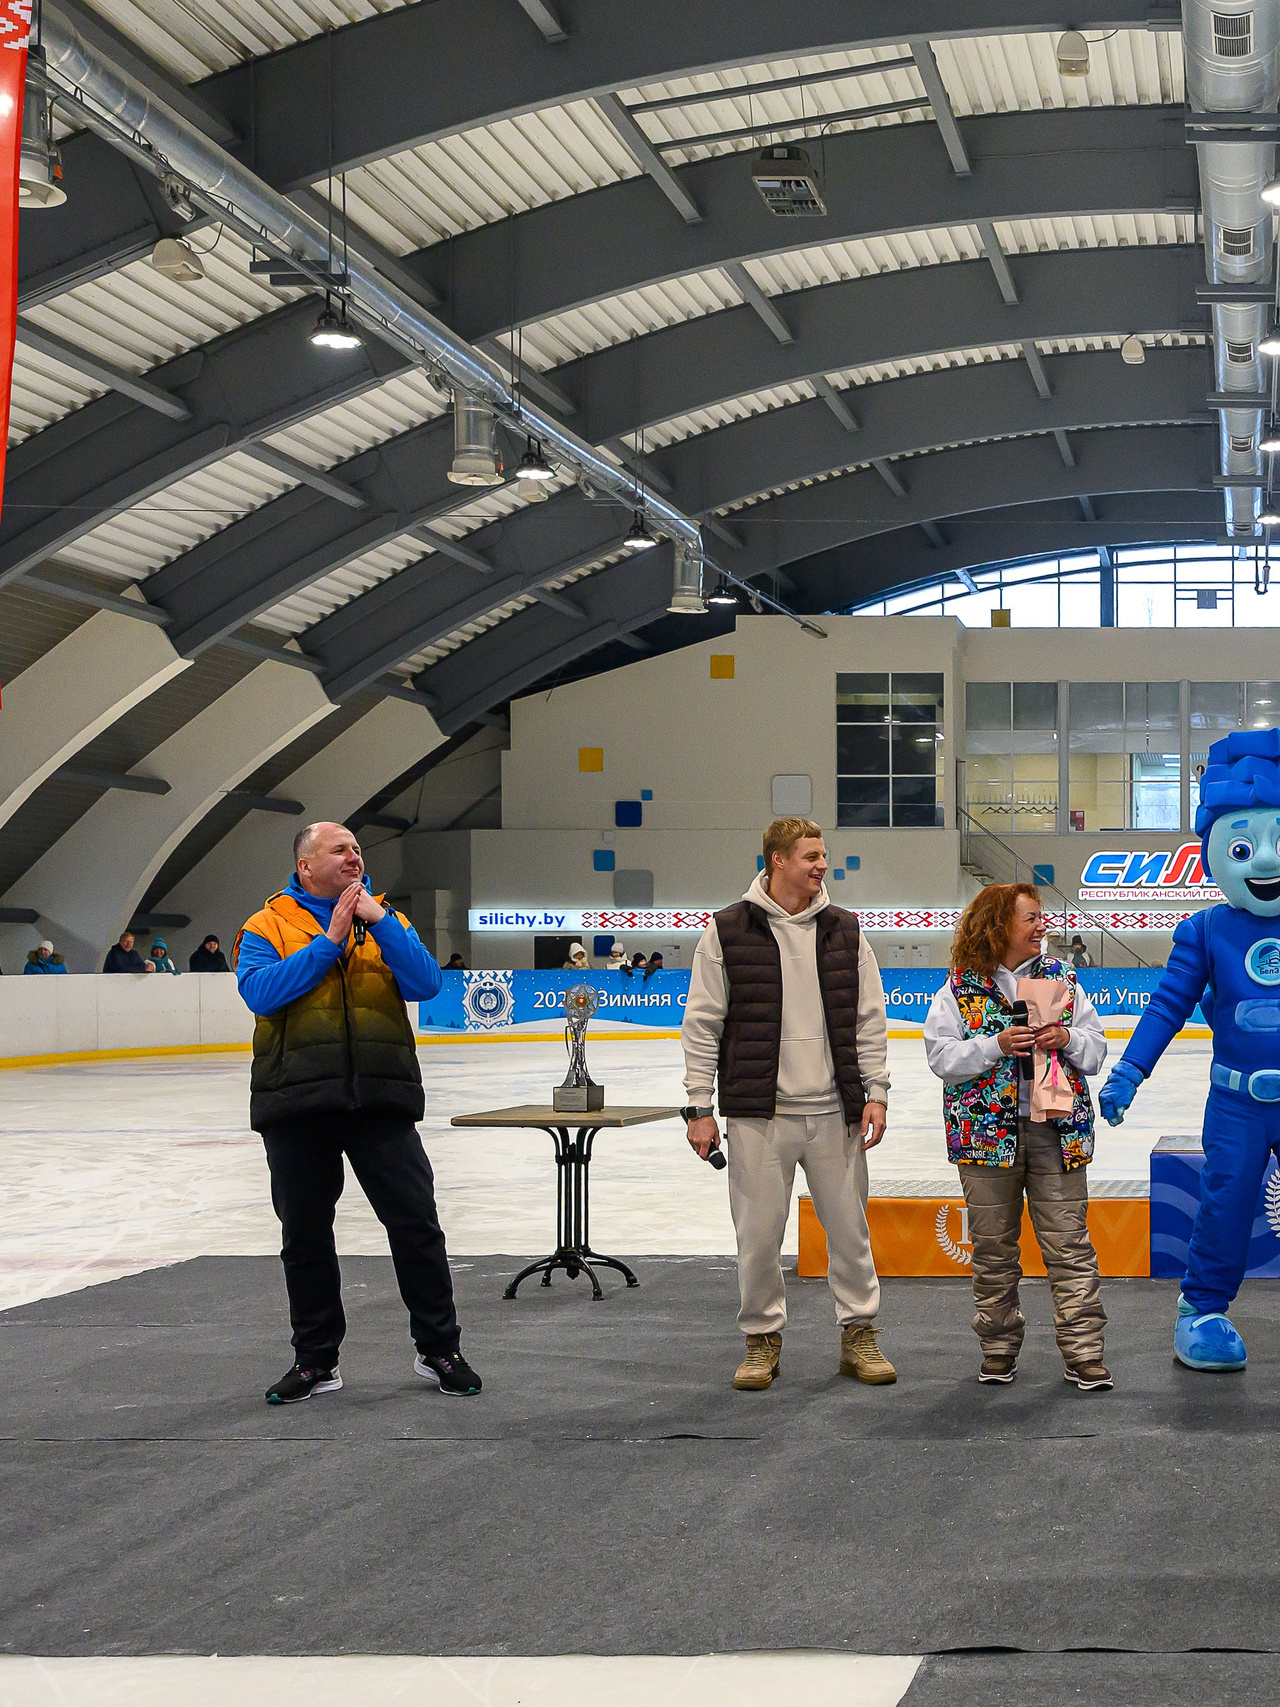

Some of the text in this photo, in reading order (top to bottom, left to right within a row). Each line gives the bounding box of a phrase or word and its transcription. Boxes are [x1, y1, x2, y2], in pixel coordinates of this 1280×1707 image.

[1081, 888, 1200, 898] РЕСПУБЛИКАНСКИЙ
[479, 912, 566, 928] silichy.by
[533, 991, 570, 1008] 202
[599, 990, 671, 1007] Зимняя
[883, 986, 935, 1005] аботн
